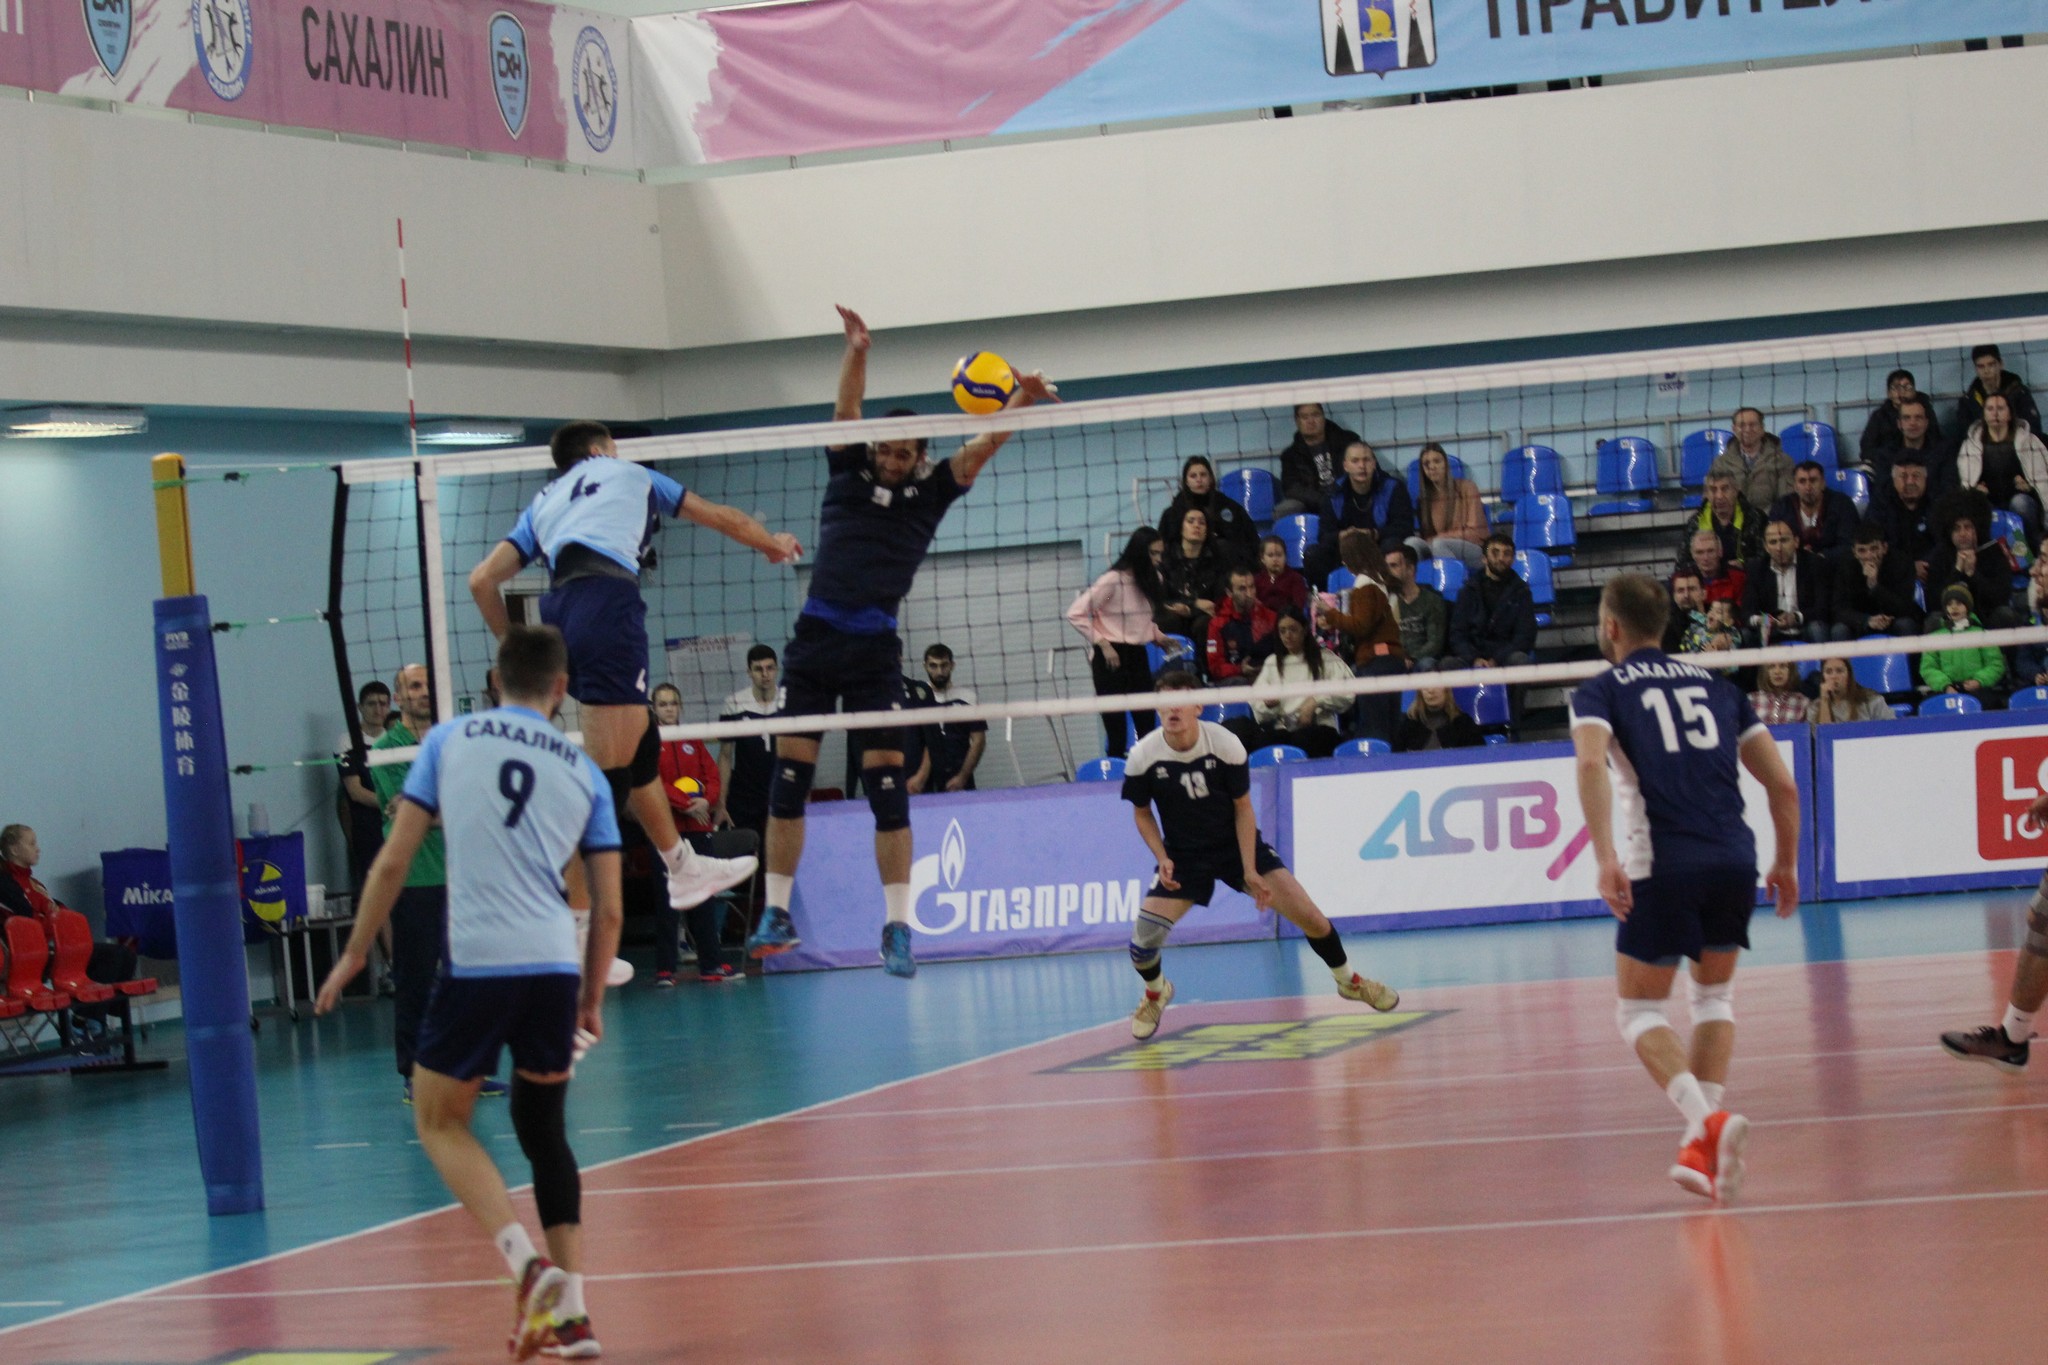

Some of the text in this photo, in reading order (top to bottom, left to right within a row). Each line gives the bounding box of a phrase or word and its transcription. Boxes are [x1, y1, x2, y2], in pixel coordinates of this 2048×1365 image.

[302, 5, 448, 99] САХАЛИН
[569, 474, 601, 502] 4
[1612, 661, 1713, 685] САХАЛИН
[464, 719, 580, 767] САХАЛИН
[1640, 685, 1720, 753] 15
[498, 758, 535, 829] 9
[1180, 771, 1210, 800] 13
[2001, 755, 2048, 801] L
[969, 878, 1140, 933] ГАЗПРОМ
